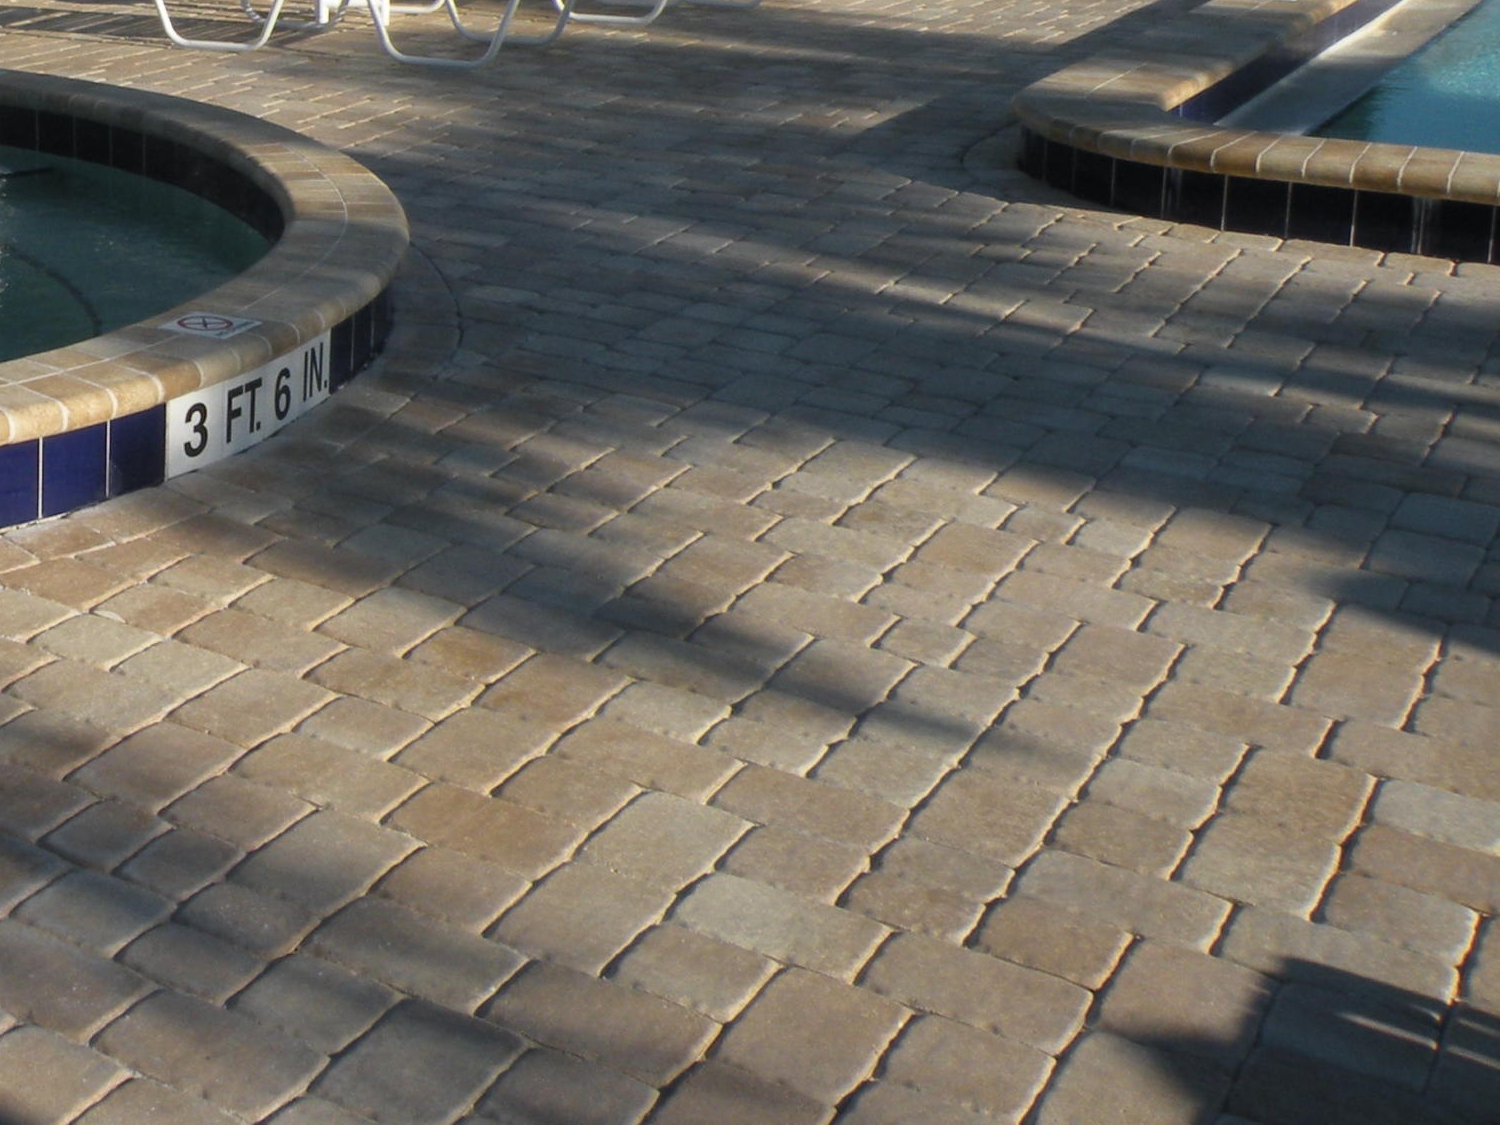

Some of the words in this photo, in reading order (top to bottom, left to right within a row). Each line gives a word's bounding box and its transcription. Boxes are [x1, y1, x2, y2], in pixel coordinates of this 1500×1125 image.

[184, 402, 208, 457] 3
[226, 378, 262, 443] FT.
[274, 367, 291, 420] 6
[303, 342, 327, 402] IN.
